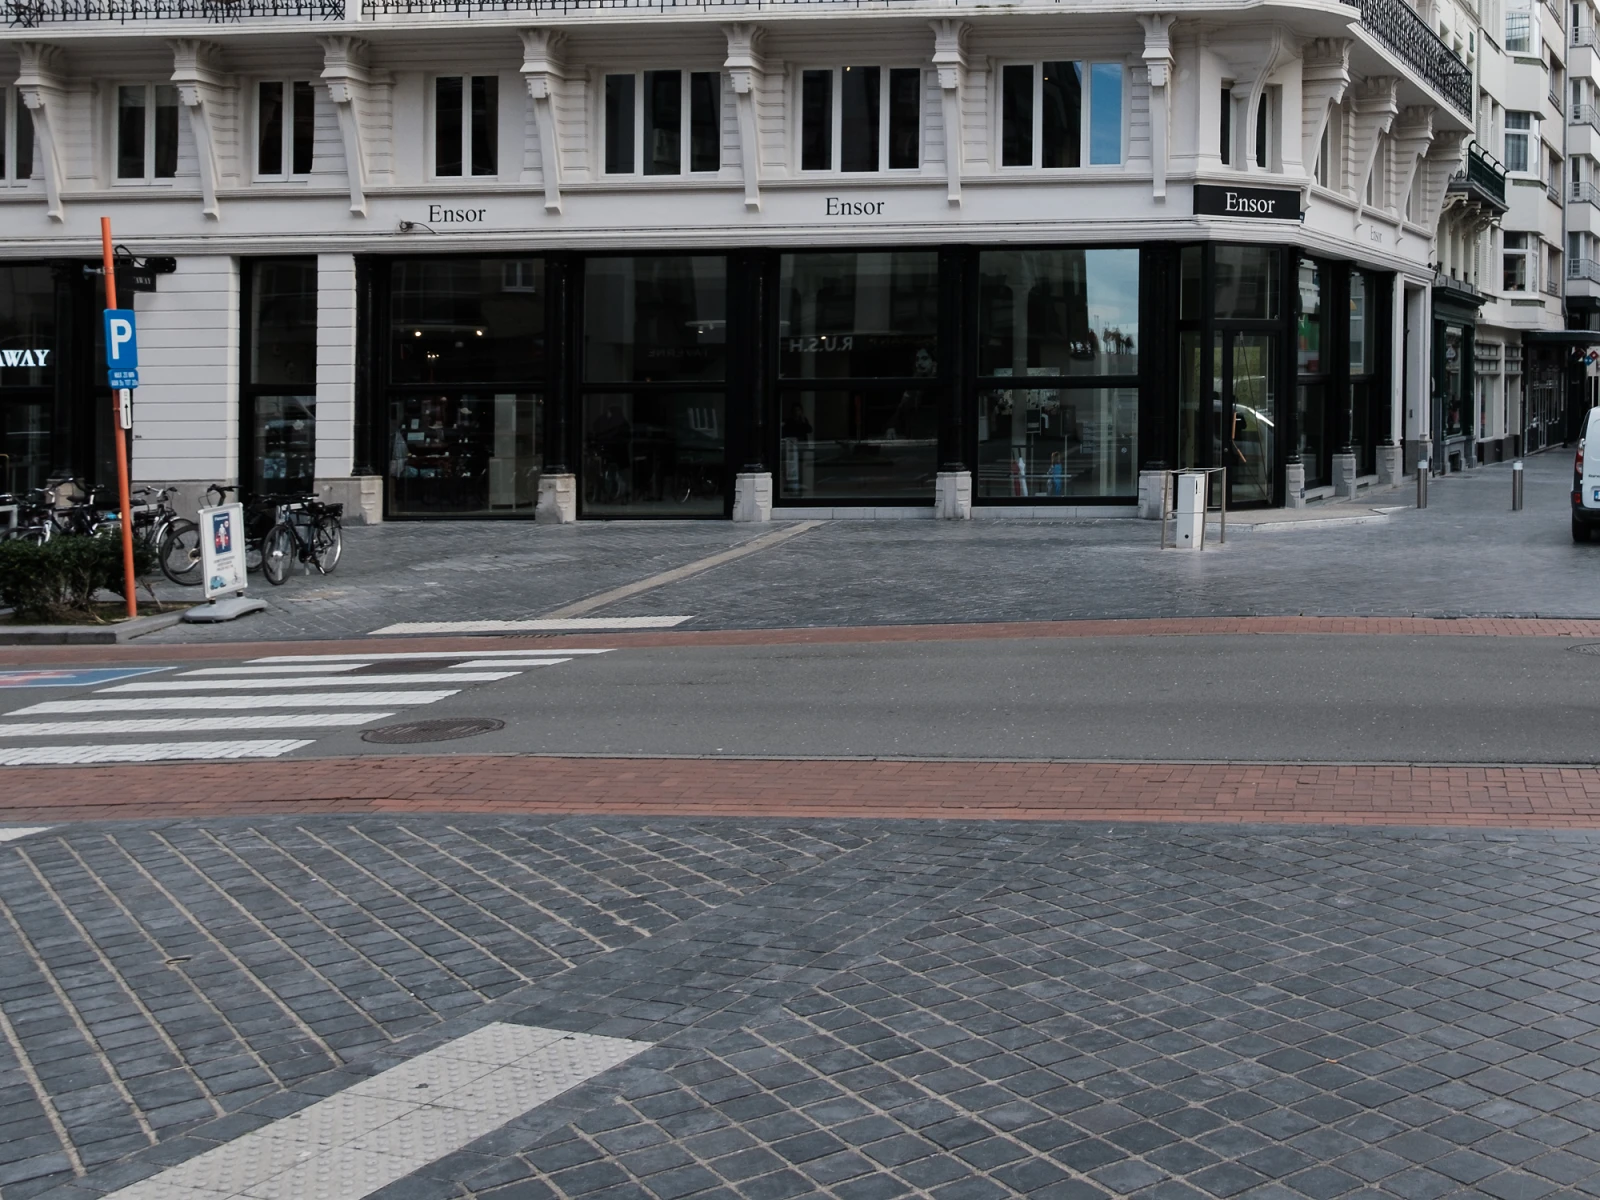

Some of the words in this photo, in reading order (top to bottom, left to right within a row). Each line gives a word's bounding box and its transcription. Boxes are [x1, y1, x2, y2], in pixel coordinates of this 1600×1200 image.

[824, 196, 885, 217] Ensor
[1225, 192, 1275, 213] Ensor
[427, 204, 487, 223] Ensor
[109, 318, 133, 360] P
